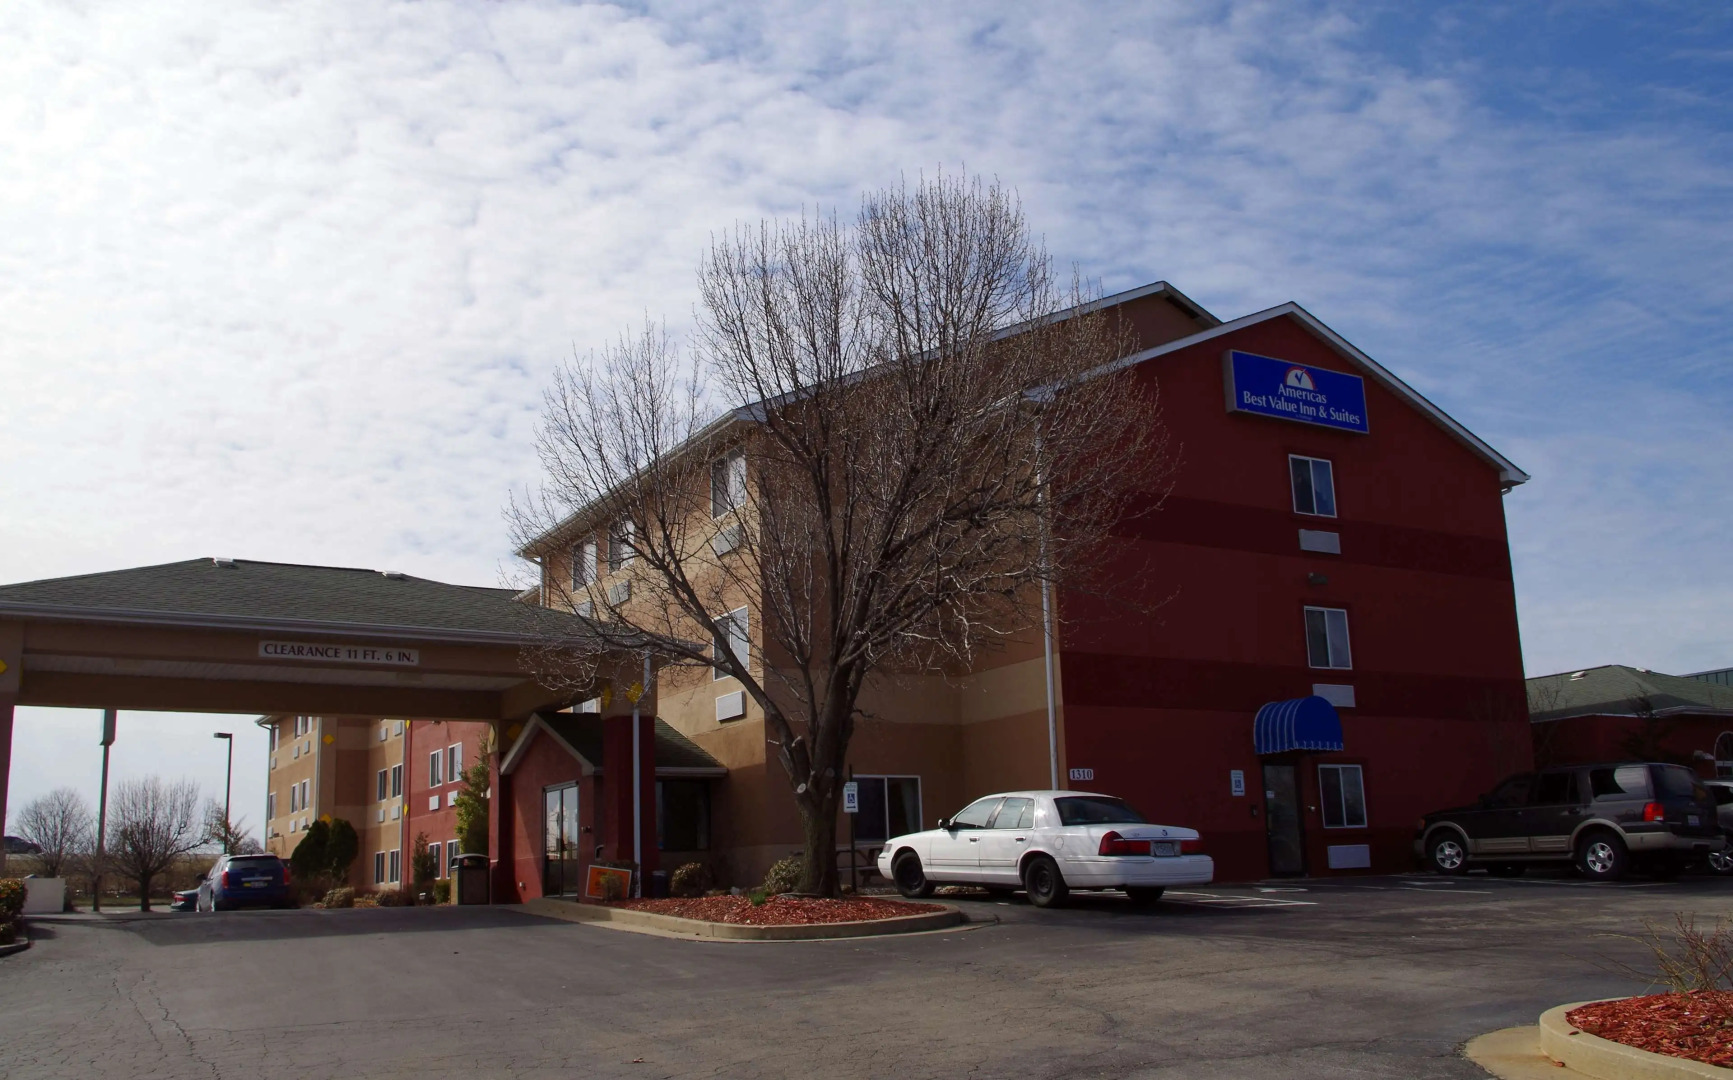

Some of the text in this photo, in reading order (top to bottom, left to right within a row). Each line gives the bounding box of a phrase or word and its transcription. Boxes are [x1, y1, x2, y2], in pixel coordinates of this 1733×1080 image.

[1278, 383, 1327, 404] Americas
[1243, 391, 1267, 407] Best
[1269, 395, 1297, 412] Value
[1300, 402, 1316, 416] Inn
[1319, 405, 1327, 418] &
[1330, 408, 1360, 424] Suites
[264, 644, 414, 662] CLEARANCE 11 FT. 6 IN.
[1072, 769, 1092, 779] 1310
